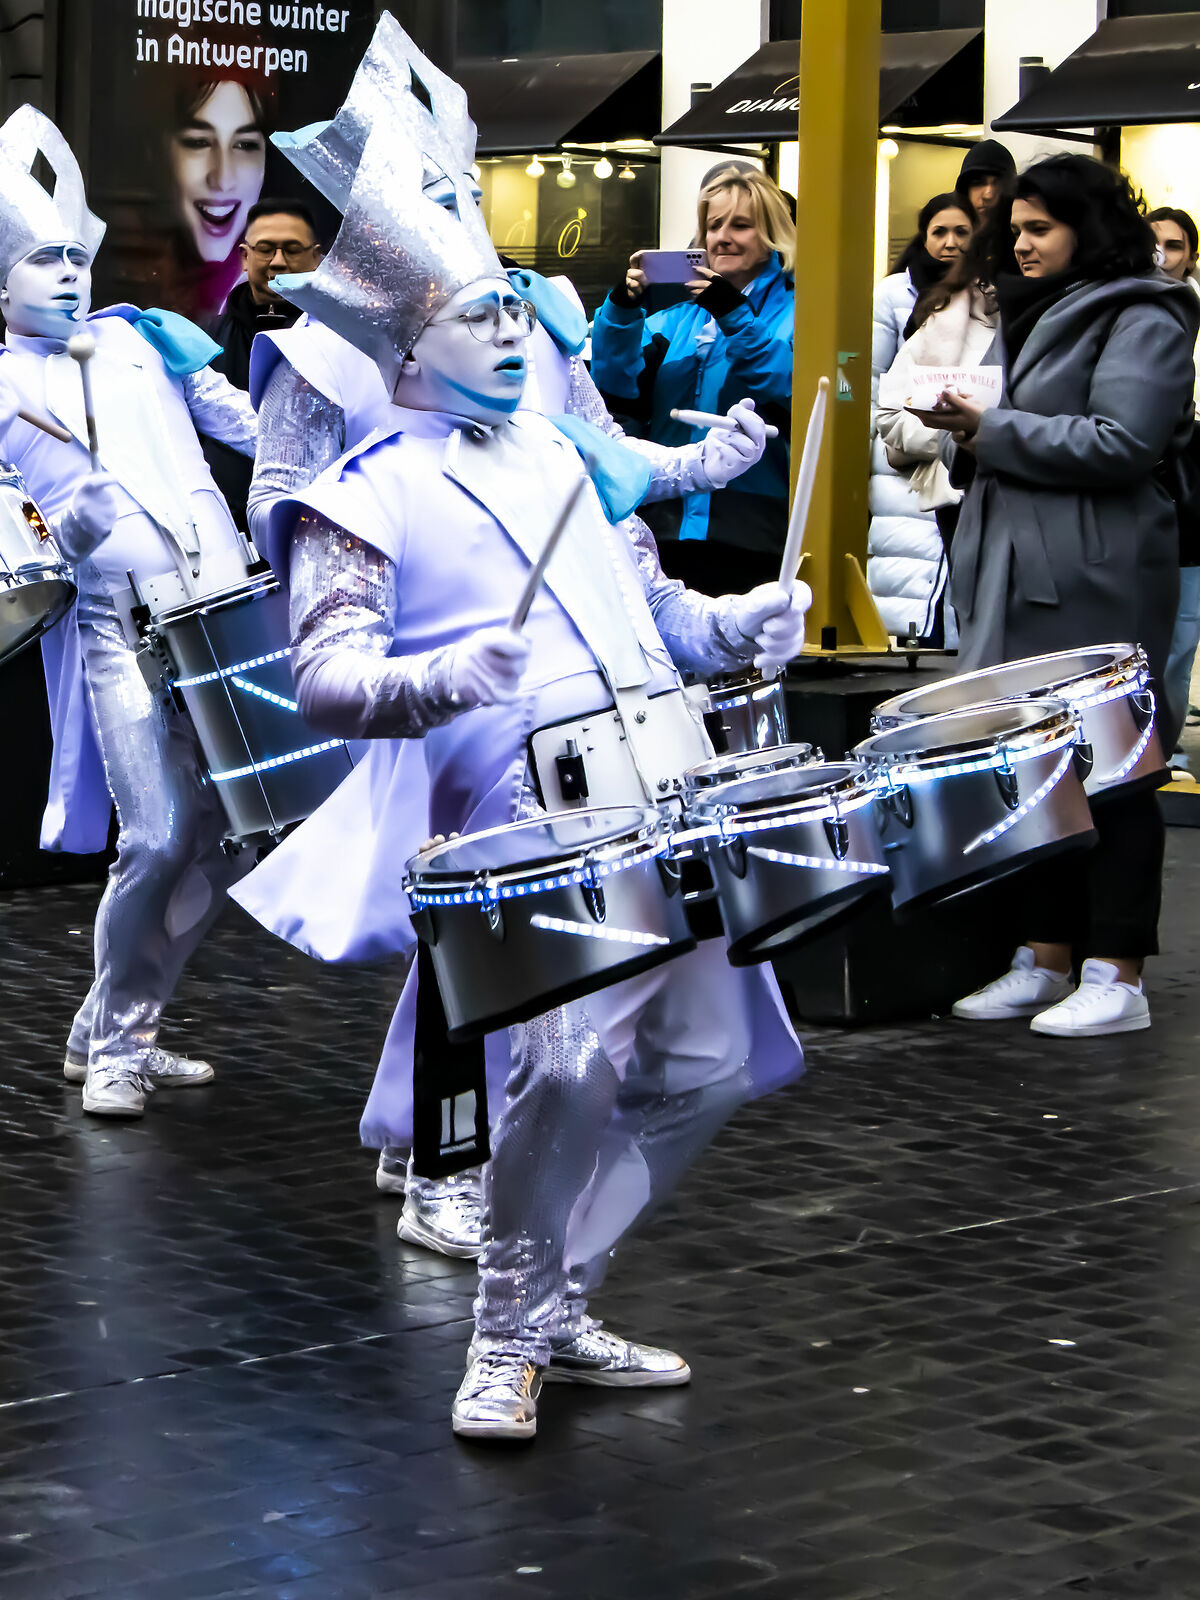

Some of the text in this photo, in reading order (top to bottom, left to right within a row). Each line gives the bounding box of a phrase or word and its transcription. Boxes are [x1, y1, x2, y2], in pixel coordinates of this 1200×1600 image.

[137, 0, 350, 32] magische winter
[136, 29, 308, 76] in Antwerpen
